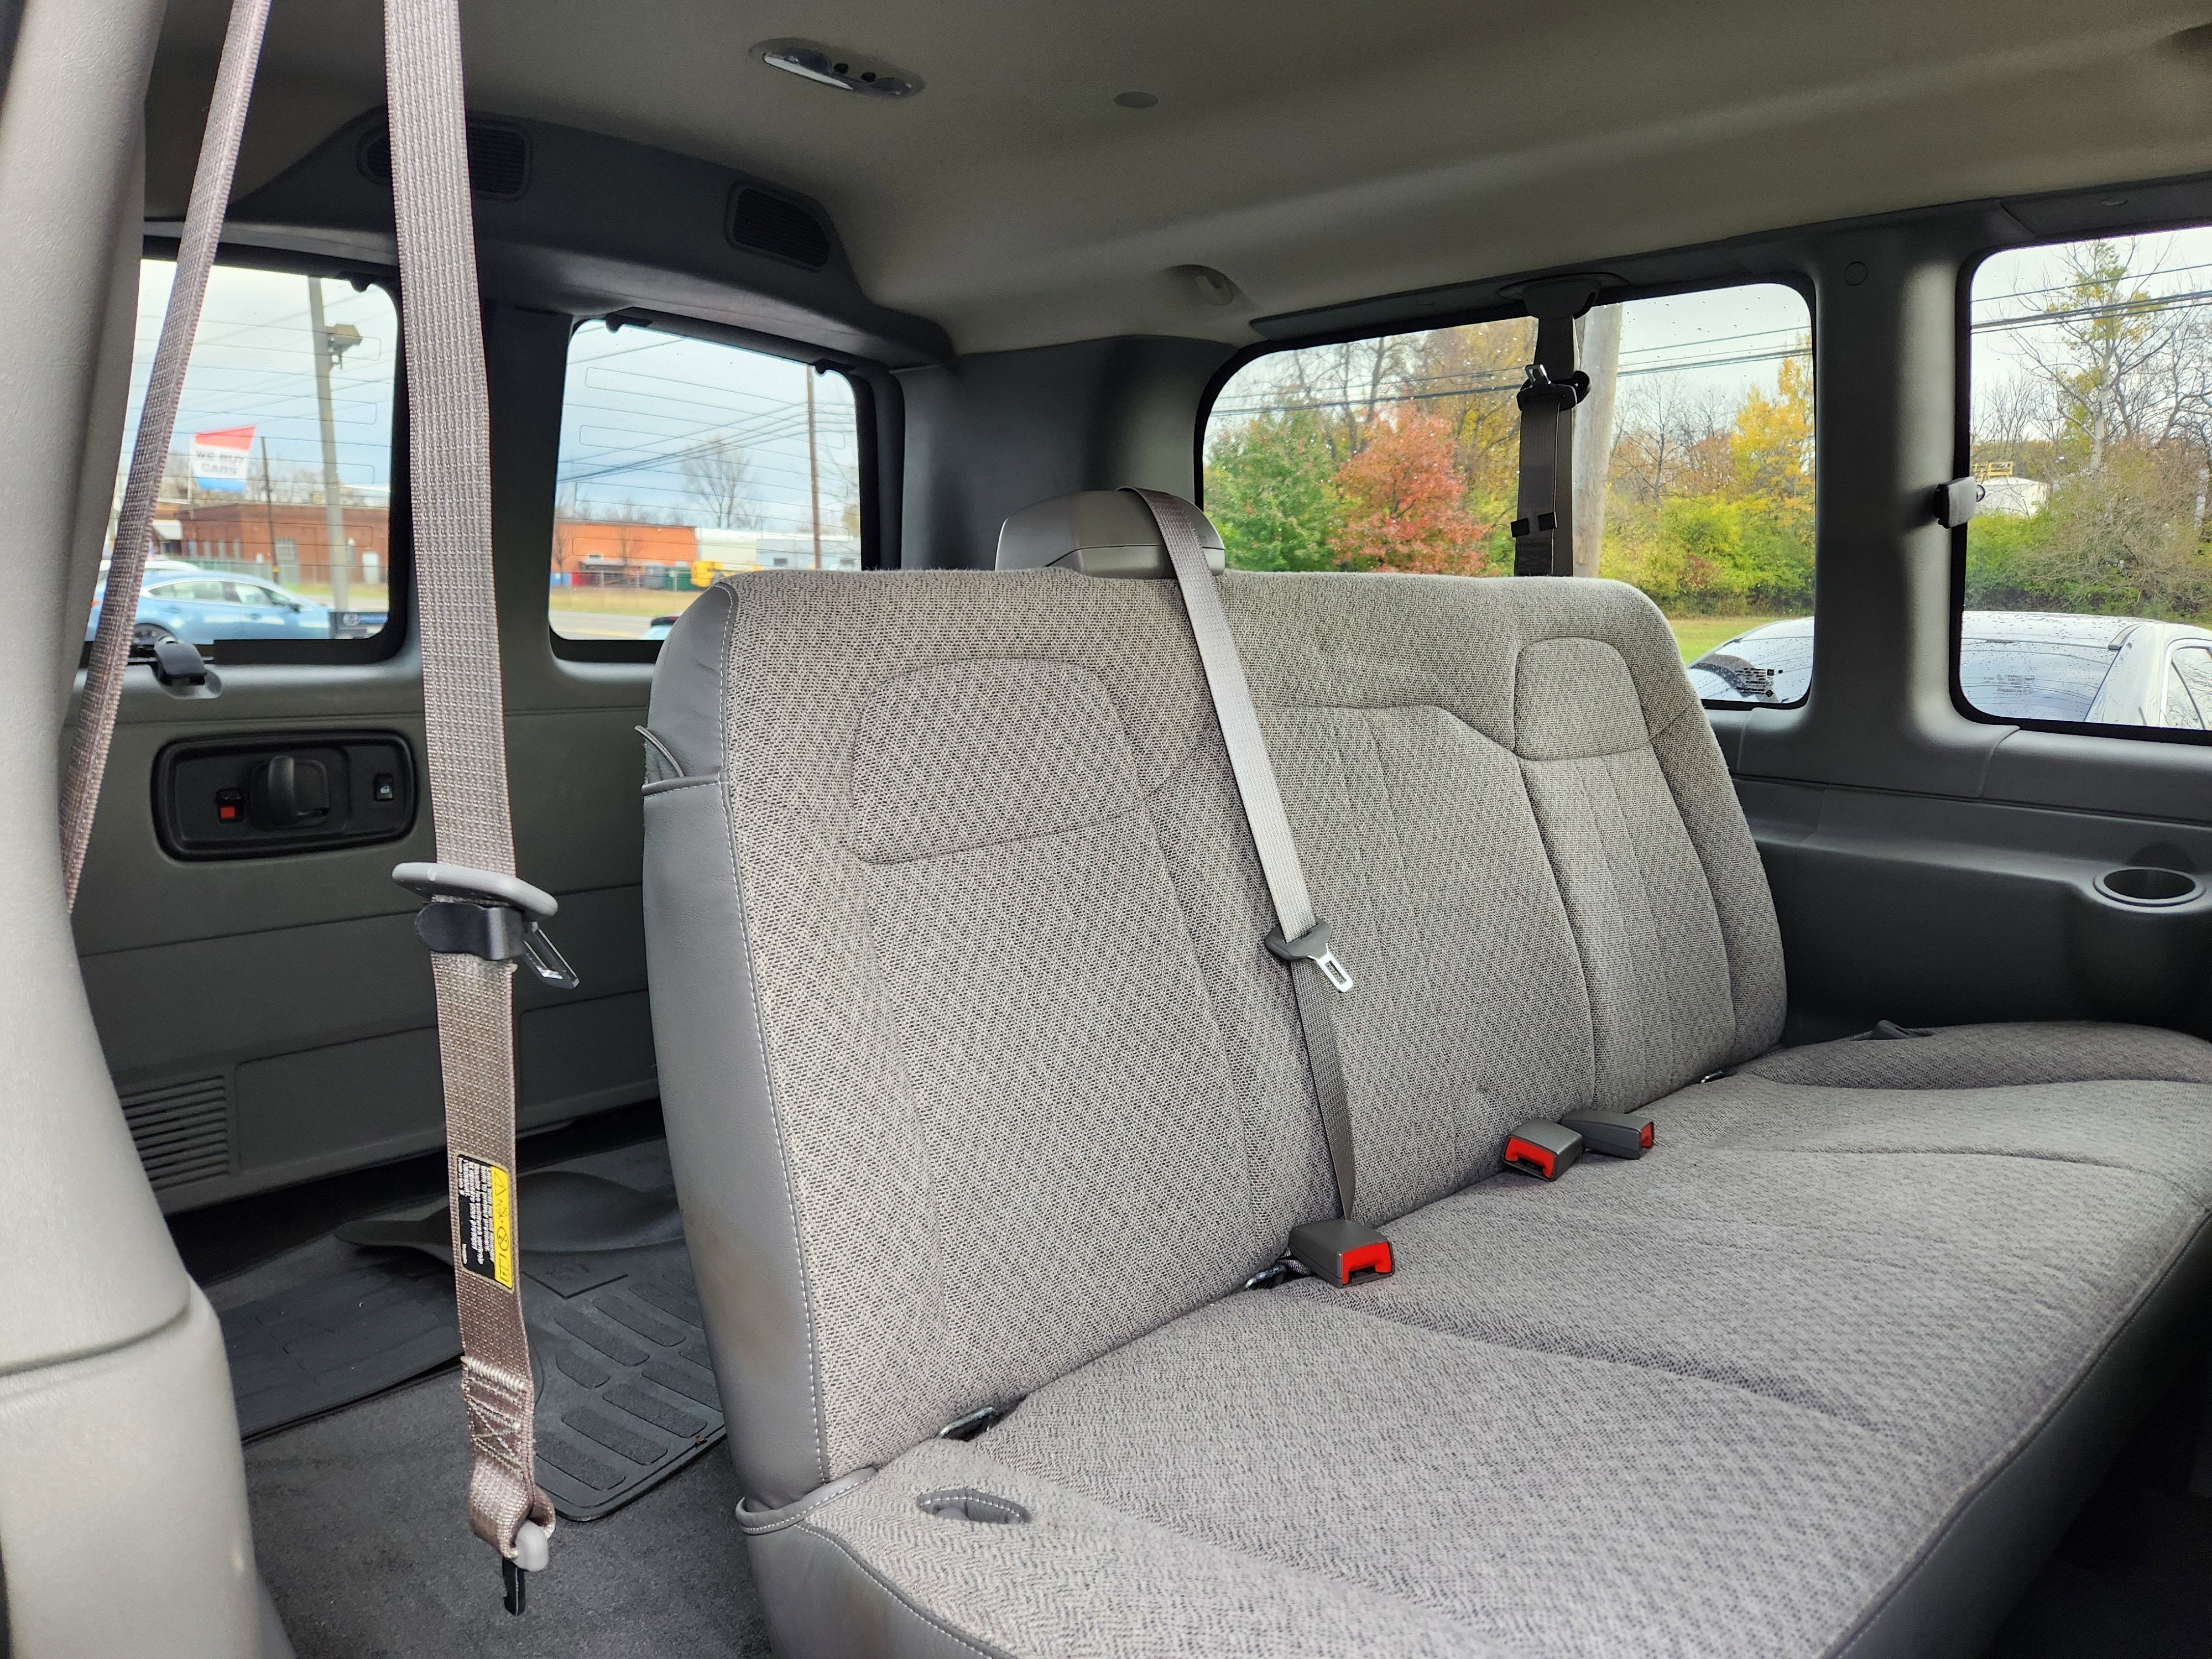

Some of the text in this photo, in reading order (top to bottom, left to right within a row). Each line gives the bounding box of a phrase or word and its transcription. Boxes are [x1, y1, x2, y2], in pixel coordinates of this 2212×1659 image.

[196, 450, 244, 465] WE BUY
[201, 463, 238, 474] CARS
